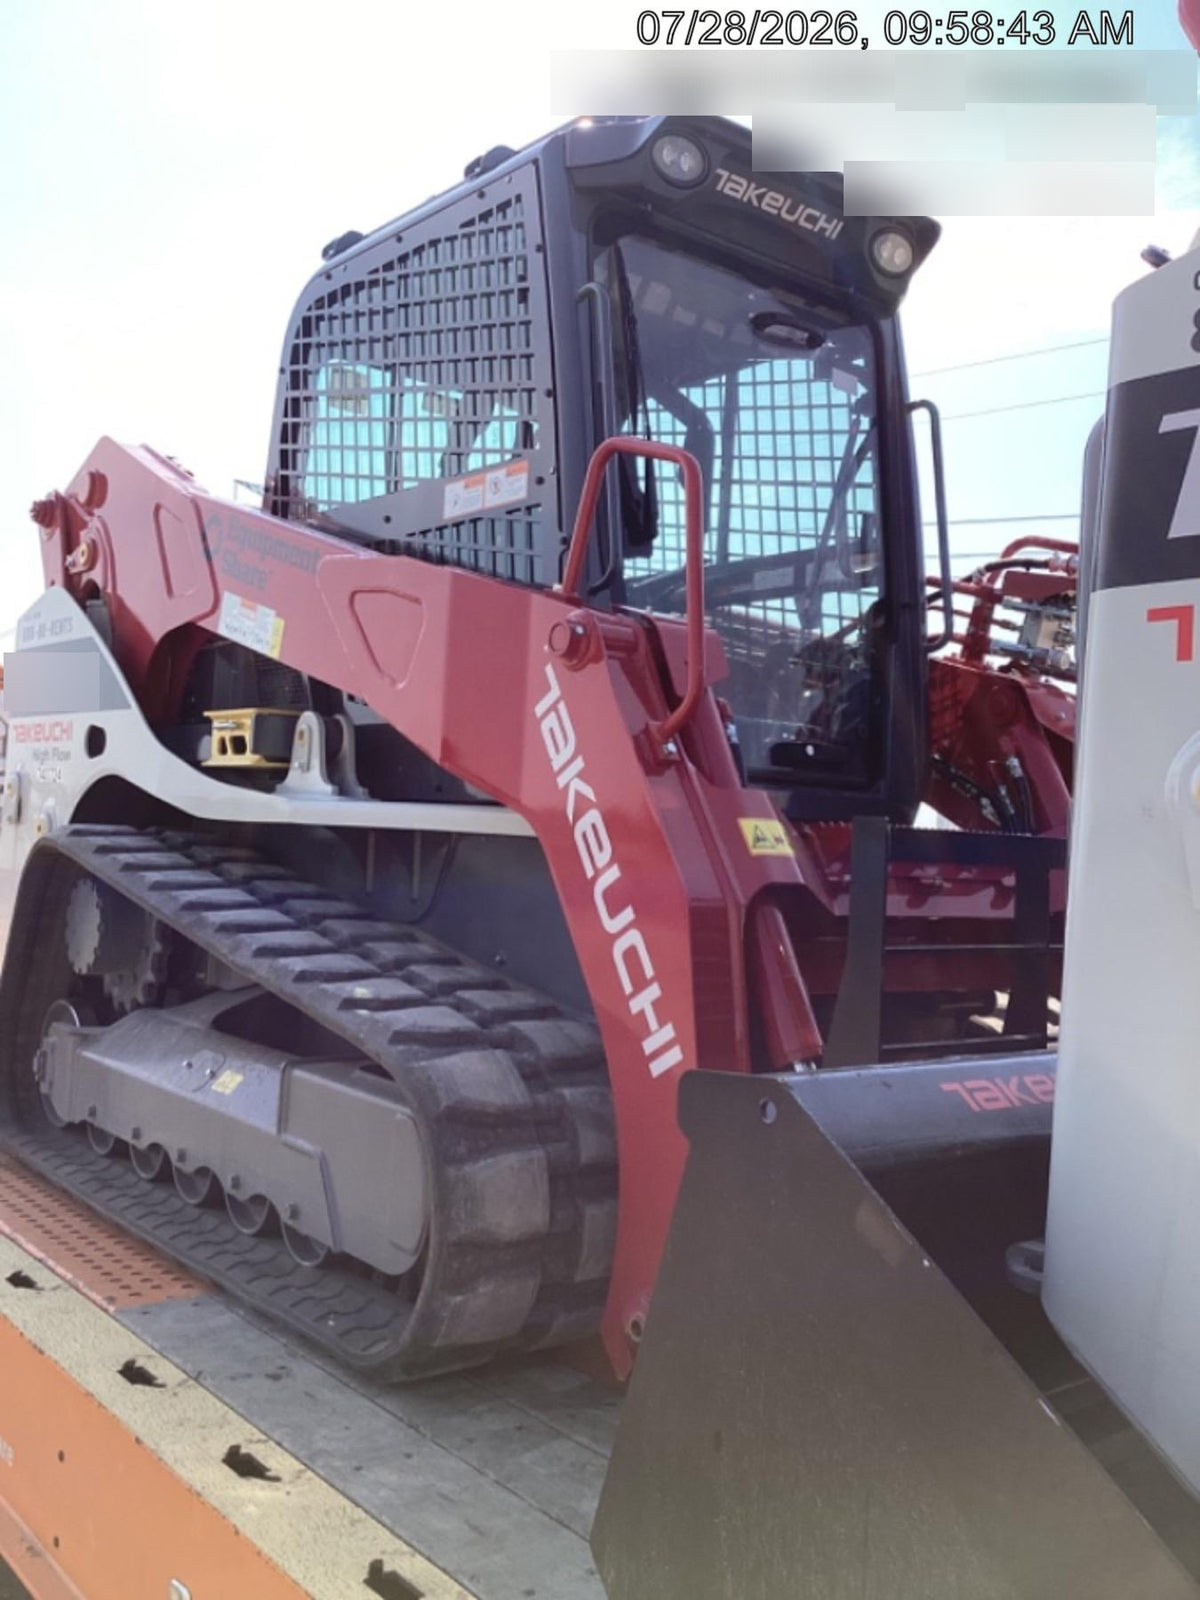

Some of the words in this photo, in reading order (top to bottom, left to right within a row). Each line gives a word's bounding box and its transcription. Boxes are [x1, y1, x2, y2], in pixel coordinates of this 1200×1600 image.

[715, 168, 844, 240] TAKEUCHI
[534, 663, 684, 1080] TAKEUCHI
[940, 1073, 1056, 1112] TAKE
